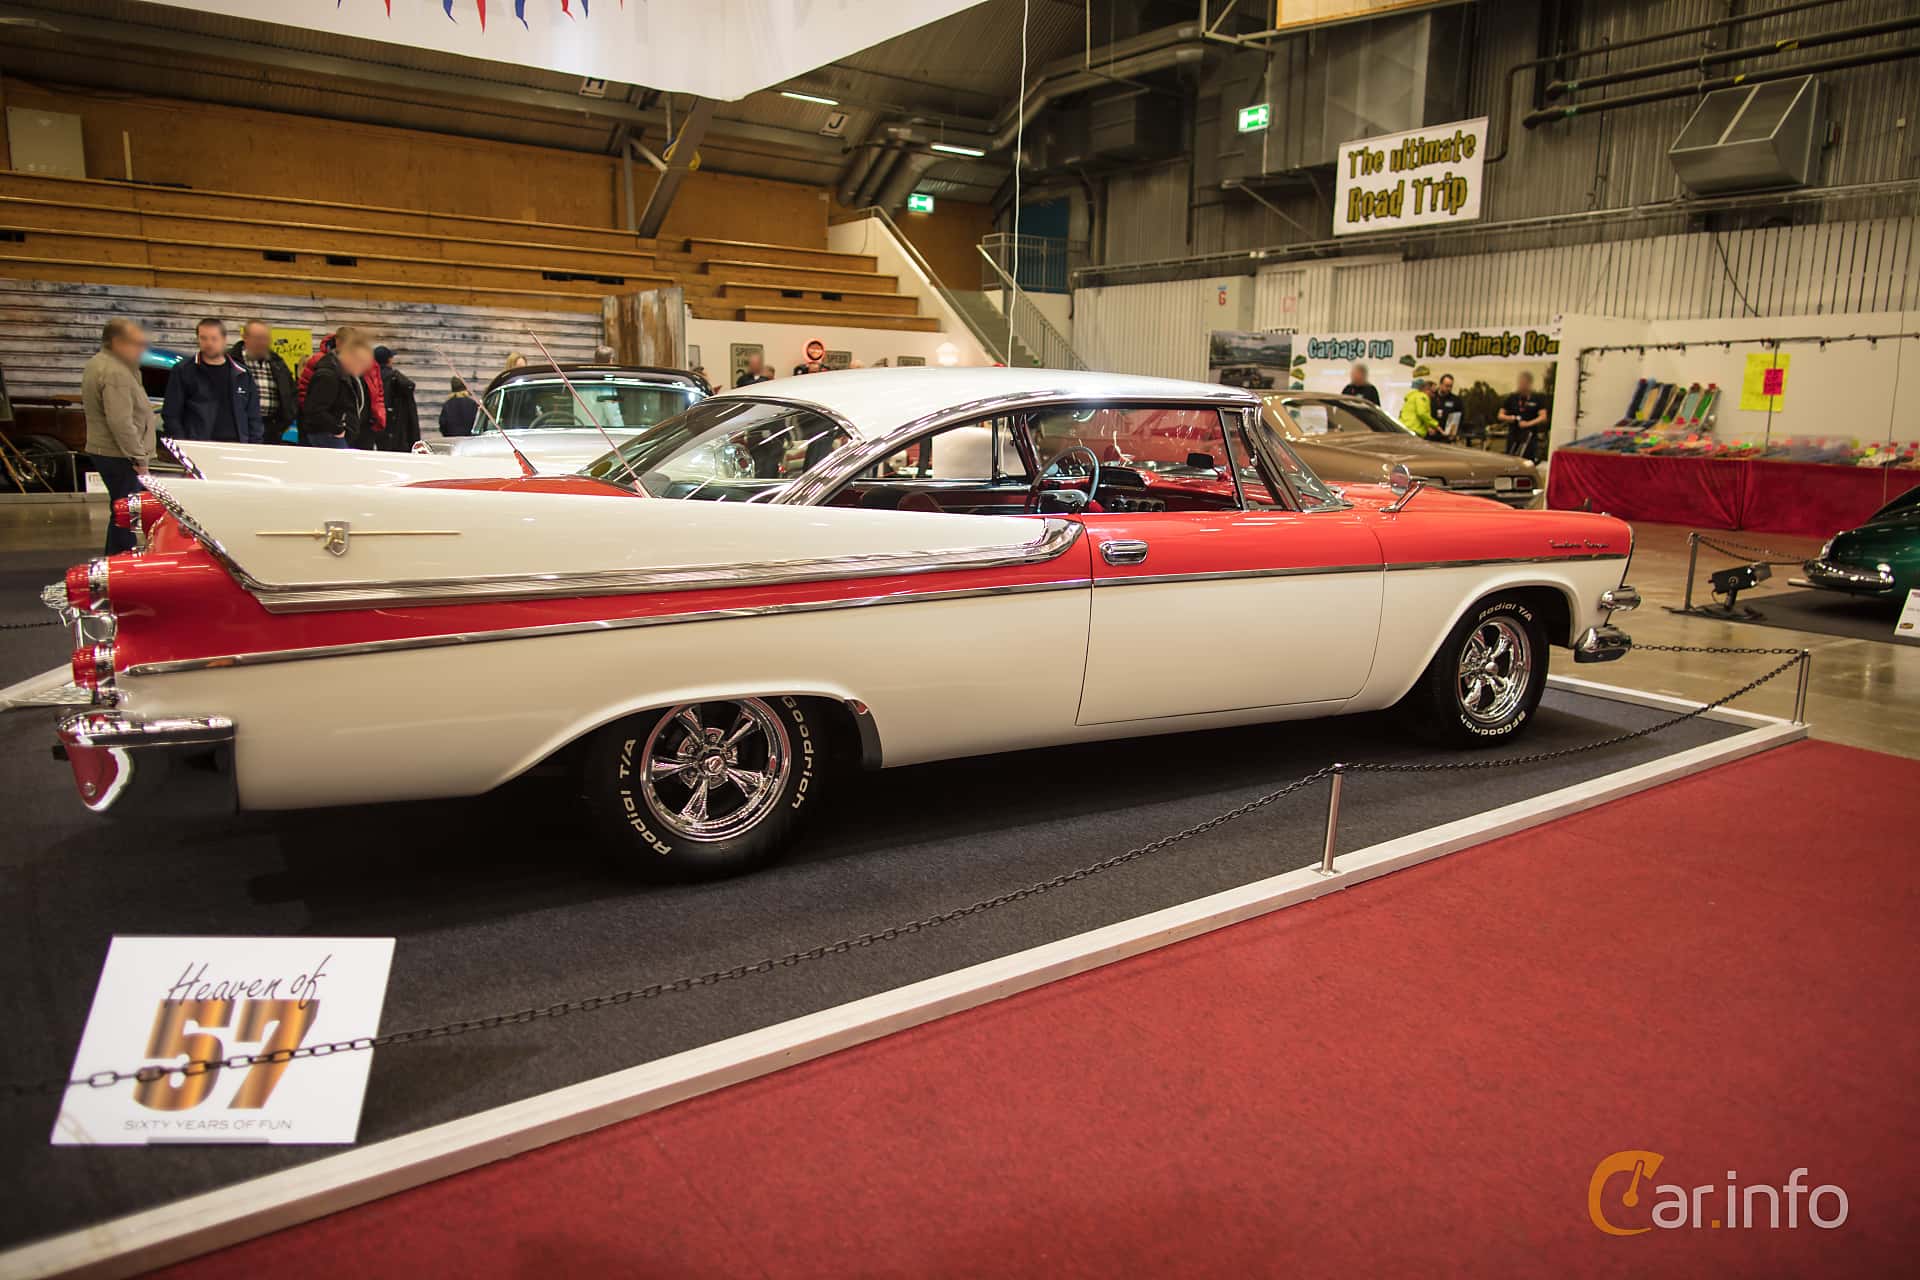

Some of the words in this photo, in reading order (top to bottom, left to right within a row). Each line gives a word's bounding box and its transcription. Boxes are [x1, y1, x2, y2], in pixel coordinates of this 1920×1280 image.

[1348, 146, 1385, 179] The
[1390, 129, 1477, 172] ultimate
[1347, 179, 1405, 223] Road
[1412, 171, 1468, 216] Trip
[1308, 337, 1366, 361] Garbage
[1368, 339, 1394, 360] run
[1415, 332, 1447, 359] The
[1449, 331, 1521, 358] ultimate
[1479, 602, 1516, 620] Radial
[1517, 607, 1533, 621] T/A
[1460, 710, 1526, 736] BFGoodrich
[619, 739, 636, 779] T/A
[620, 790, 672, 855] Radial
[164, 962, 282, 1008] Heaven
[290, 954, 332, 1010] of
[133, 999, 320, 1111] 57
[123, 1119, 171, 1130] SIXTY
[175, 1119, 229, 1130] YEARS
[233, 1119, 255, 1130] OF
[258, 1119, 292, 1130] FUN
